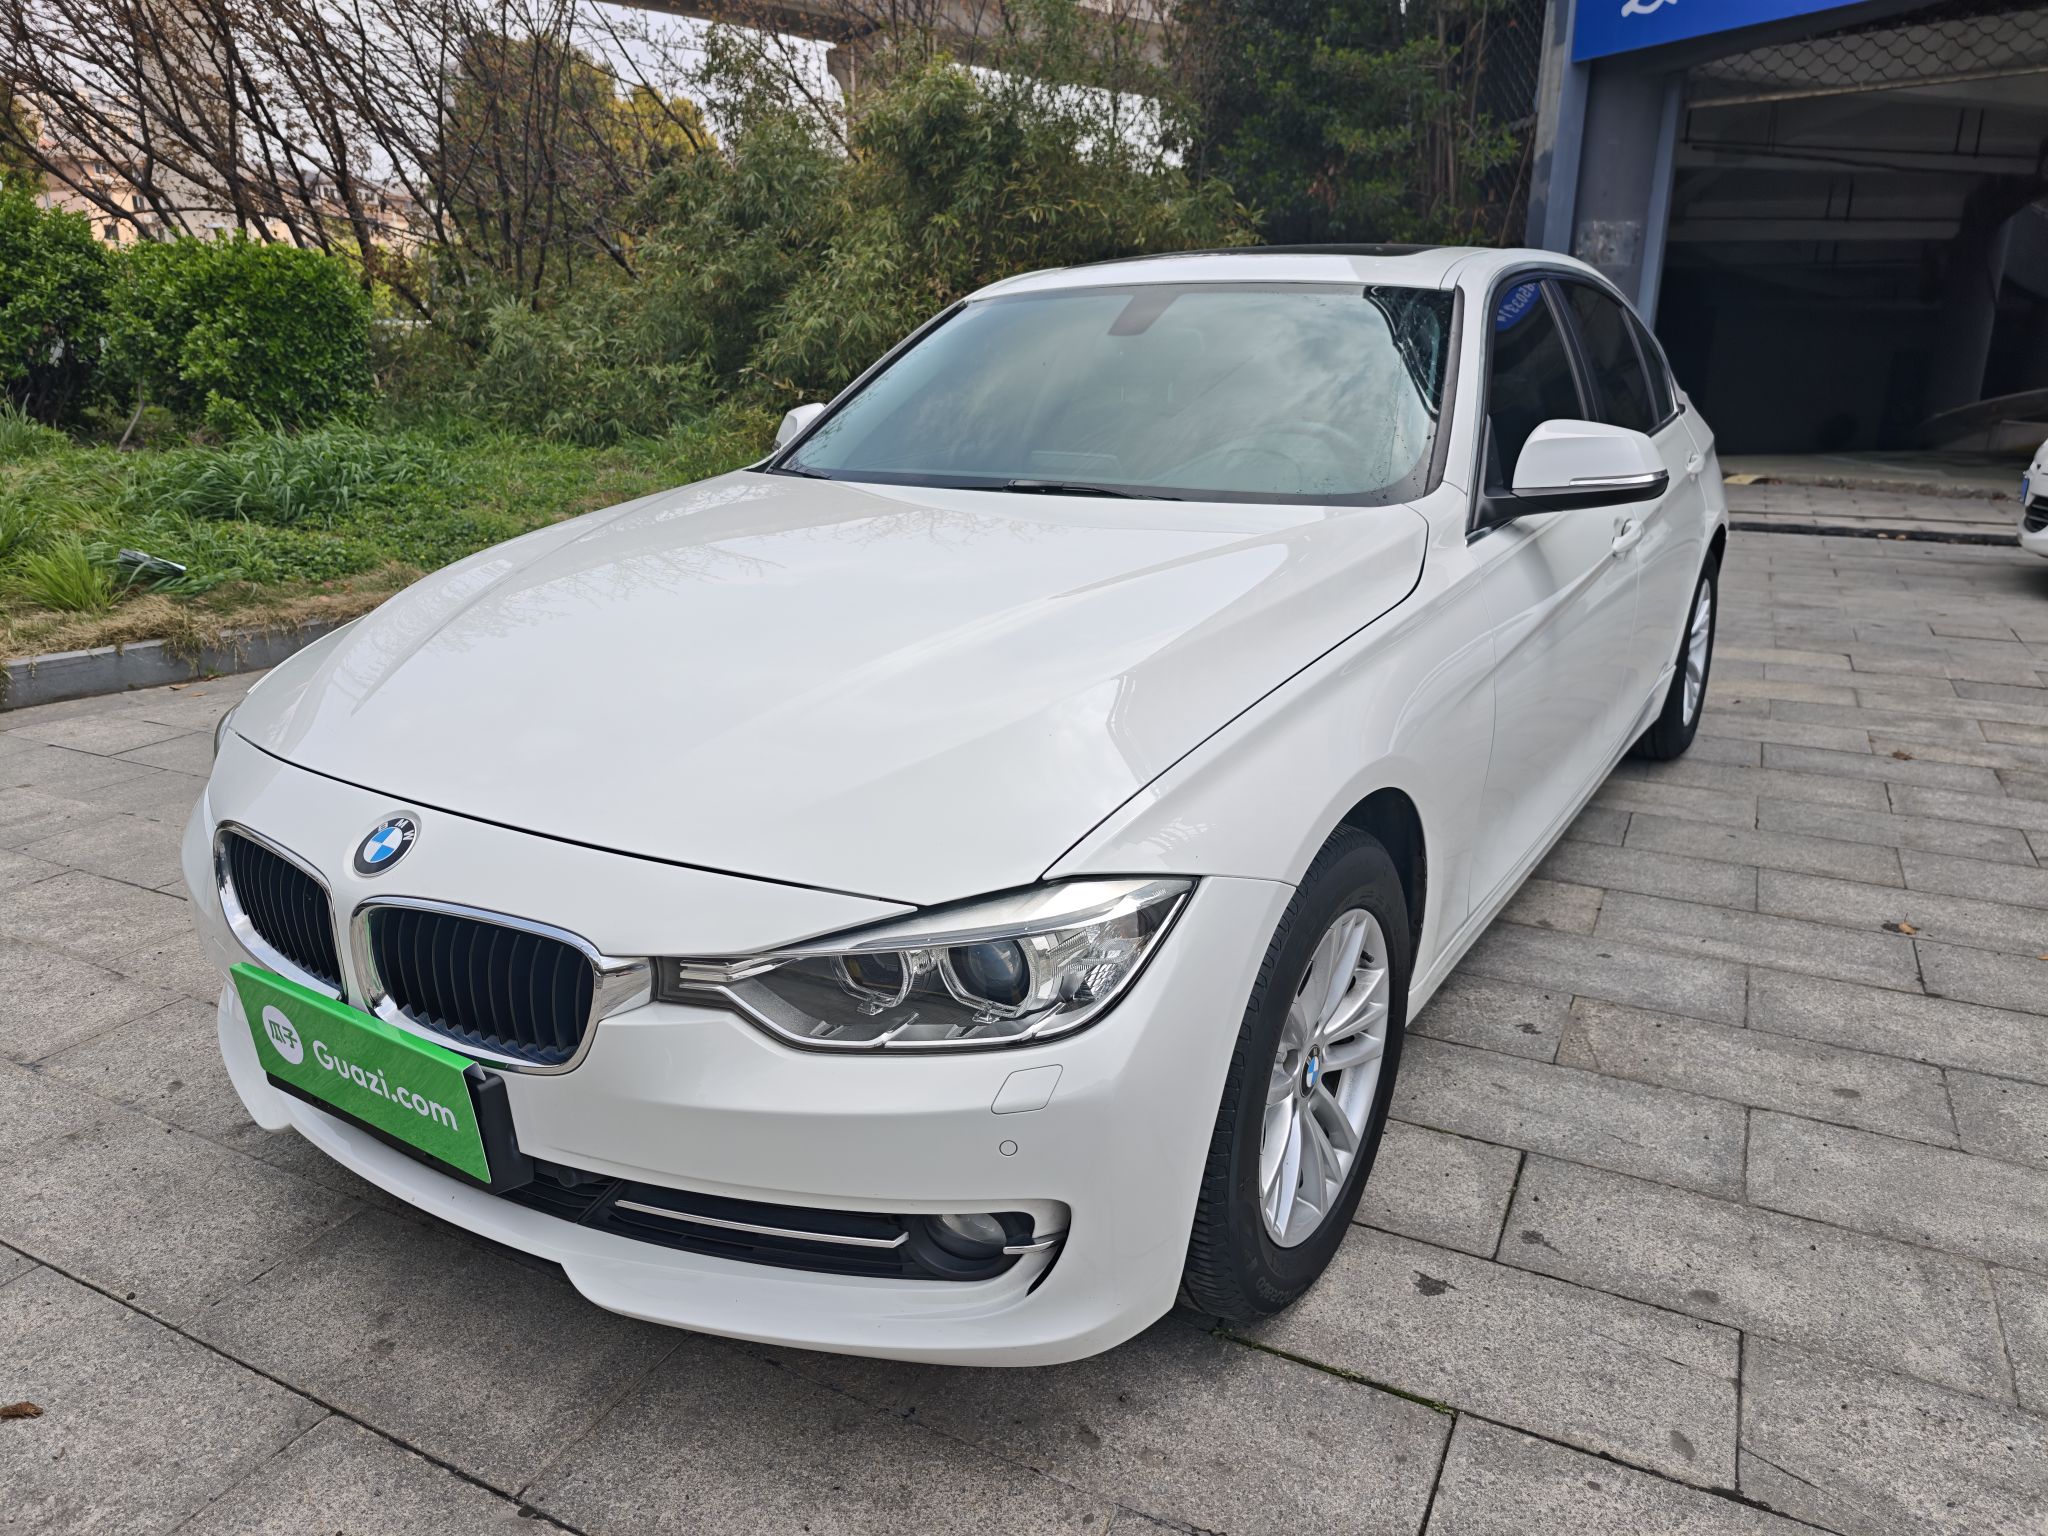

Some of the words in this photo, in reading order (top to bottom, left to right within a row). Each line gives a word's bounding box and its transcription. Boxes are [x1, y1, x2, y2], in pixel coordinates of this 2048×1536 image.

[378, 818, 415, 841] BMW
[267, 1018, 298, 1049] 瓜子
[312, 1039, 459, 1132] Guazi.com
